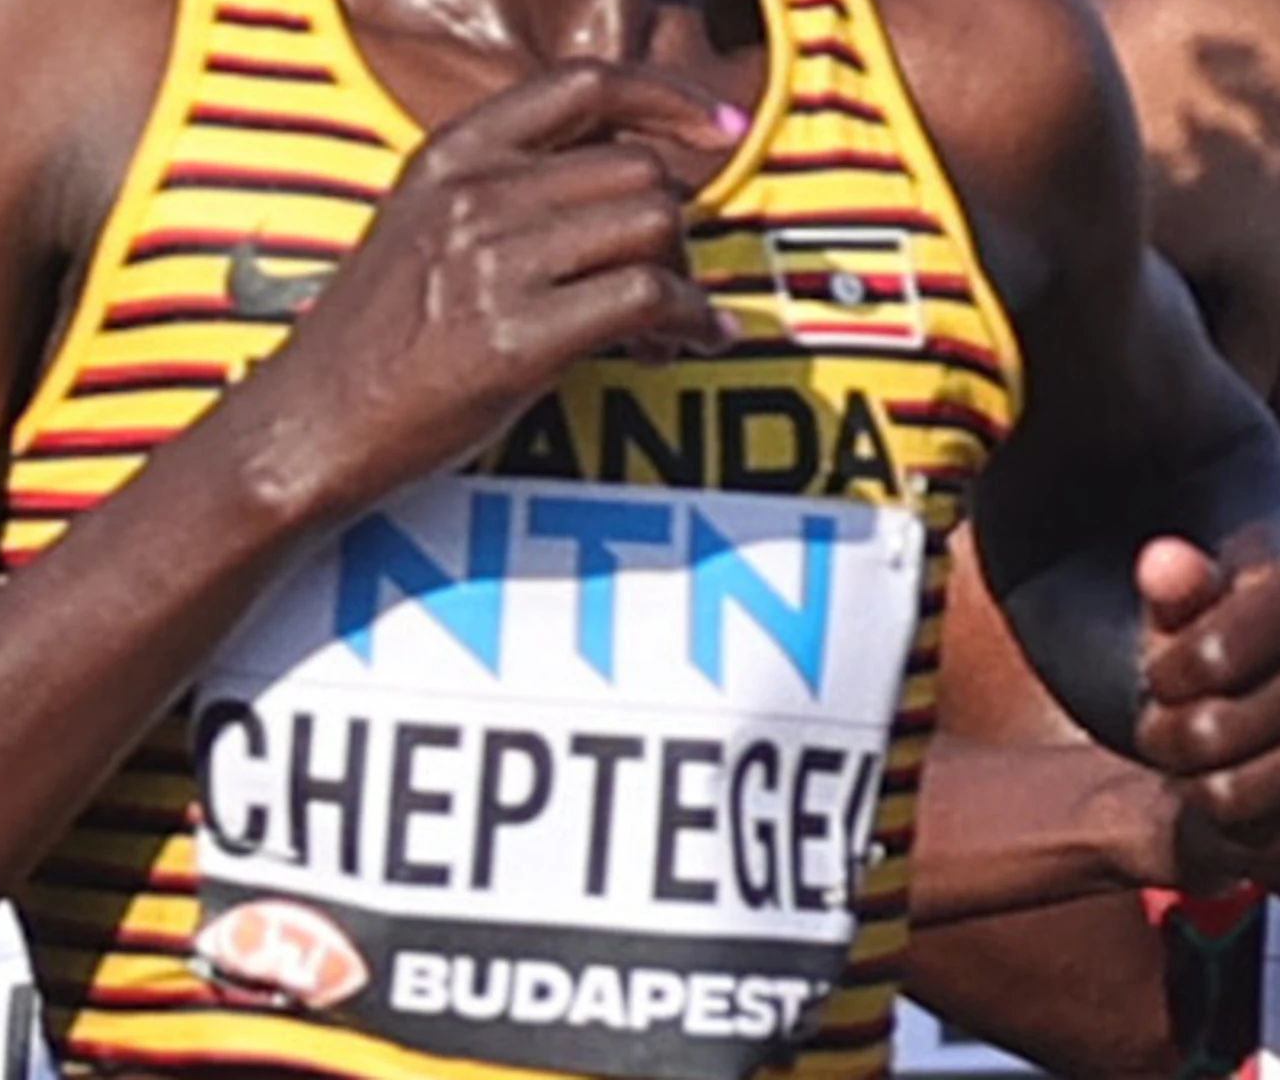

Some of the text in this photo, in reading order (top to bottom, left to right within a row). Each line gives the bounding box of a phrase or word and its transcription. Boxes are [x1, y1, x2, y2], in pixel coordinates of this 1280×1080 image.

[458, 384, 907, 499] ANDA
[331, 491, 840, 703] NTN
[193, 697, 880, 913] CHEPTEGEI
[390, 950, 812, 1040] BUDAPEST
